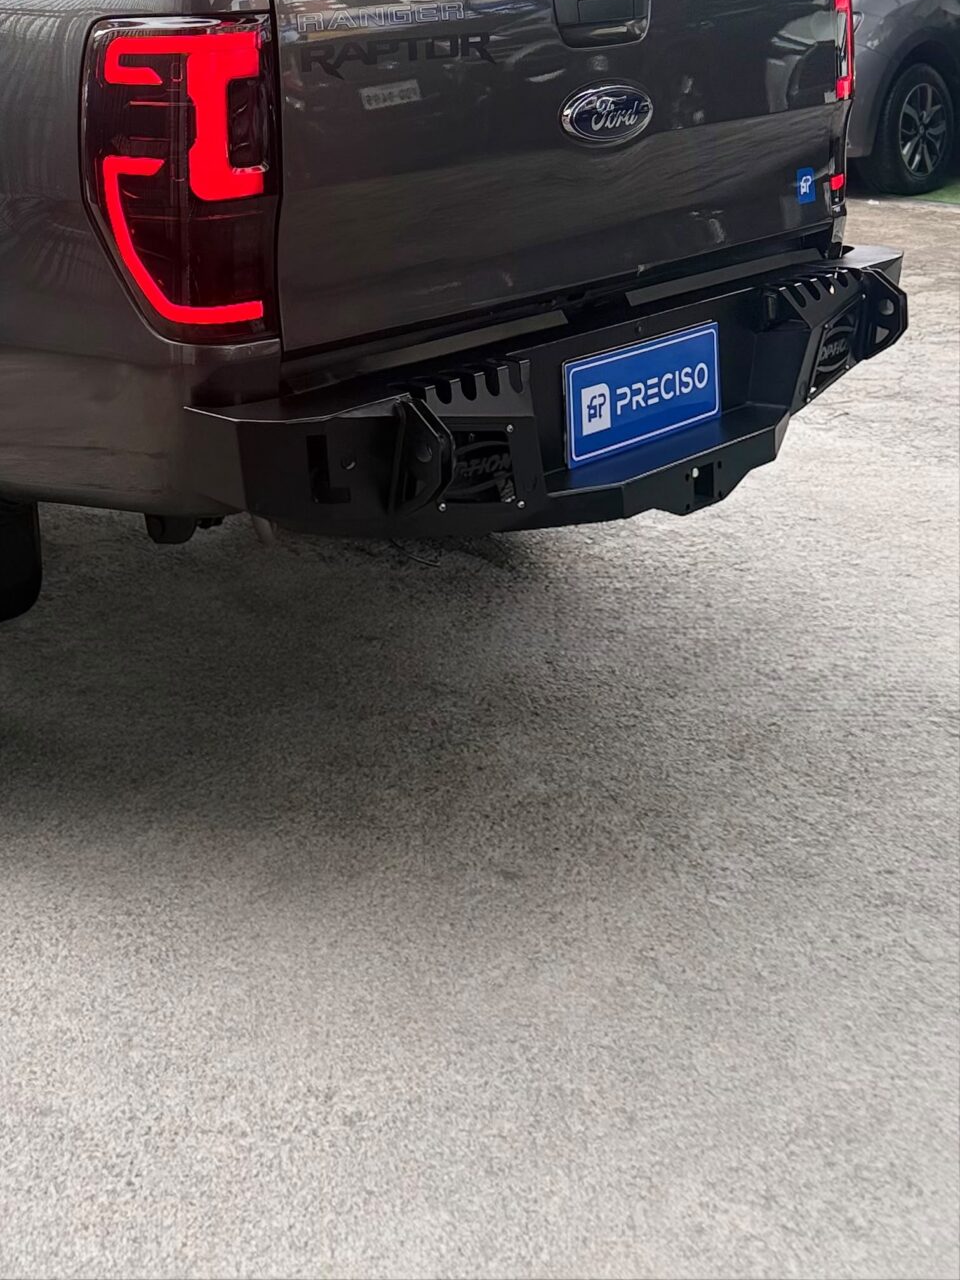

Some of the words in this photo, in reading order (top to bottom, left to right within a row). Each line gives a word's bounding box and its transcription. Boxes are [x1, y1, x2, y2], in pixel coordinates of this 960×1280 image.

[297, 1, 465, 33] RANGER
[301, 32, 497, 80] RAPTOR
[591, 95, 638, 131] Ford
[616, 362, 708, 415] PRECISO
